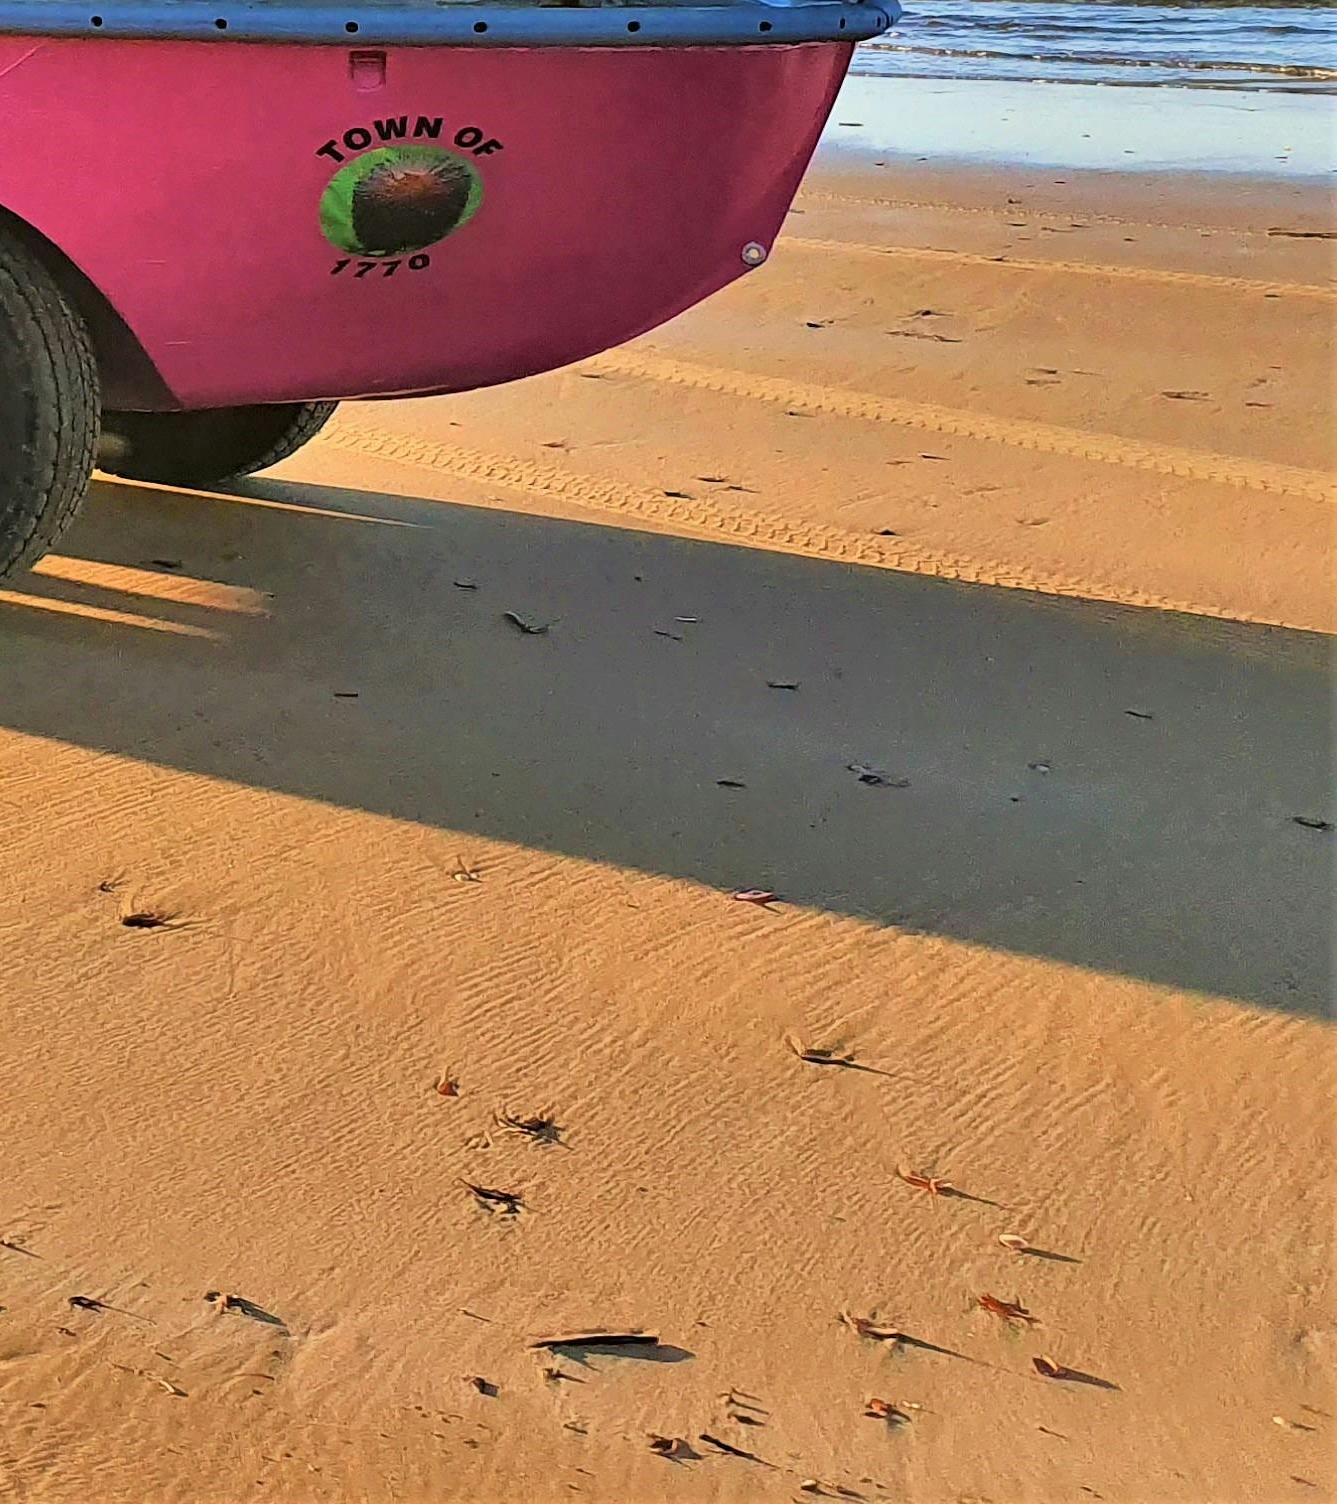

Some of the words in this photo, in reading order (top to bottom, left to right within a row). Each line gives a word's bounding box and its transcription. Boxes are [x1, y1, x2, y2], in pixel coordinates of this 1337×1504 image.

[316, 116, 444, 163] TOWN
[453, 126, 504, 156] OF
[330, 253, 431, 278] 1770
